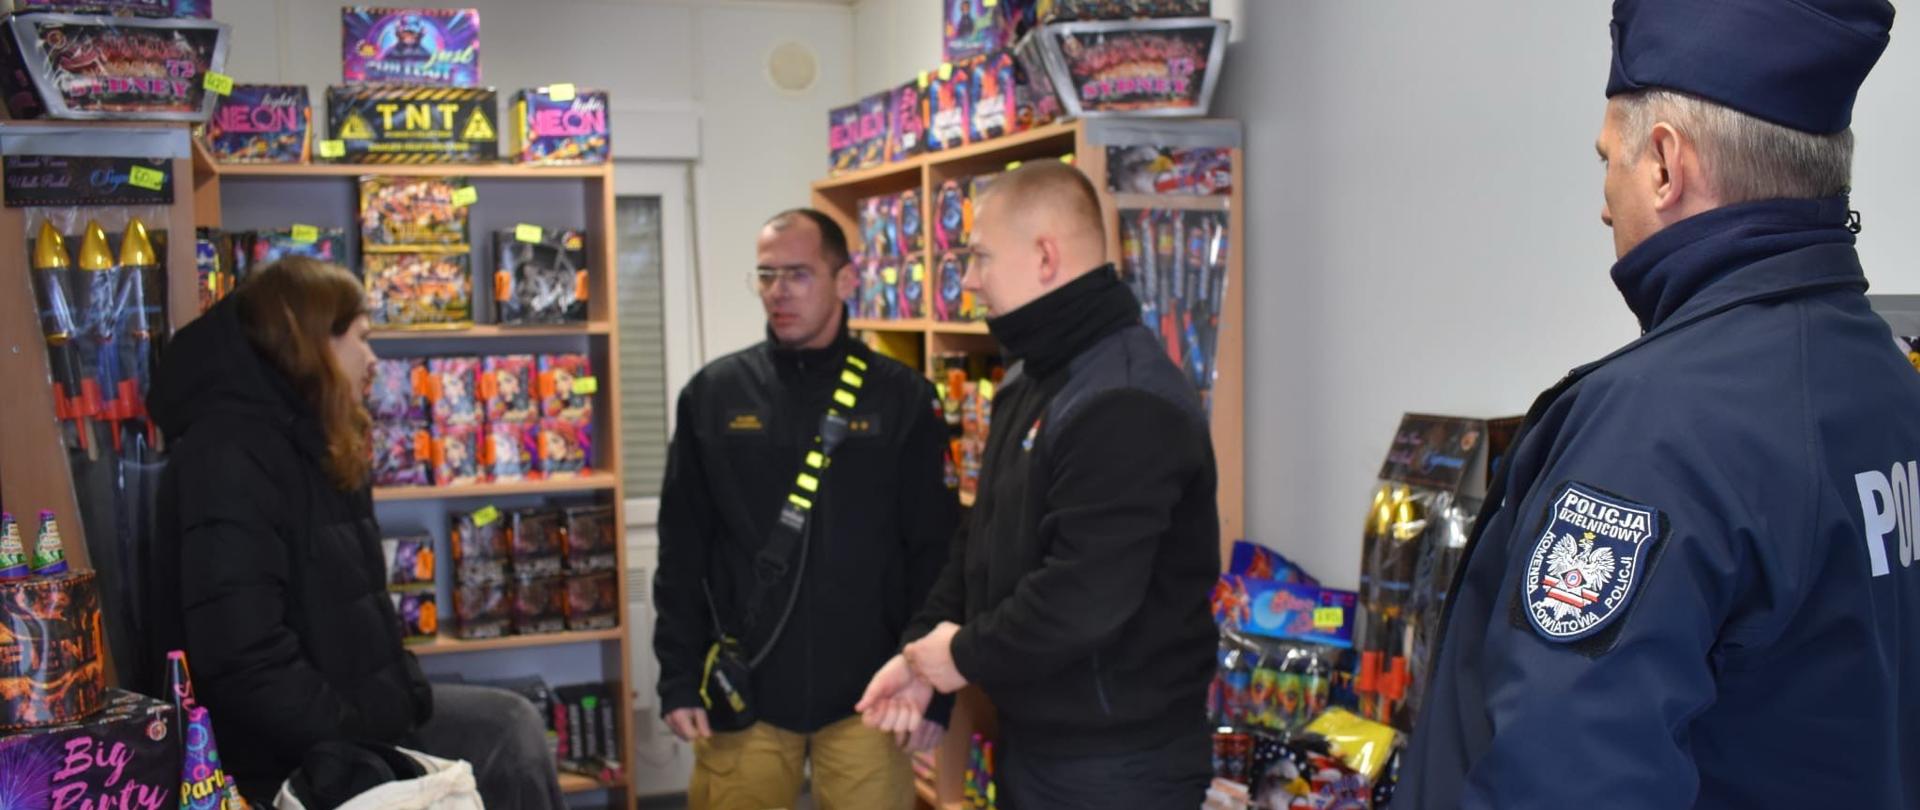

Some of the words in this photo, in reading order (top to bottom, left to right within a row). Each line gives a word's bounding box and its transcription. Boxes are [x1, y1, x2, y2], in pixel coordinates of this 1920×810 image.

[166, 59, 196, 78] 72
[70, 78, 191, 98] SYDNEY
[211, 104, 297, 132] NEON
[375, 103, 459, 130] TNT
[530, 108, 605, 136] NEON
[1558, 507, 1642, 544] DZIELNICOWY
[1564, 493, 1646, 532] POLICJA
[1529, 531, 1557, 594] KOMENDA
[1604, 557, 1633, 609] POLICJI
[1531, 600, 1600, 632] POWIATOWA
[53, 736, 135, 787] Big
